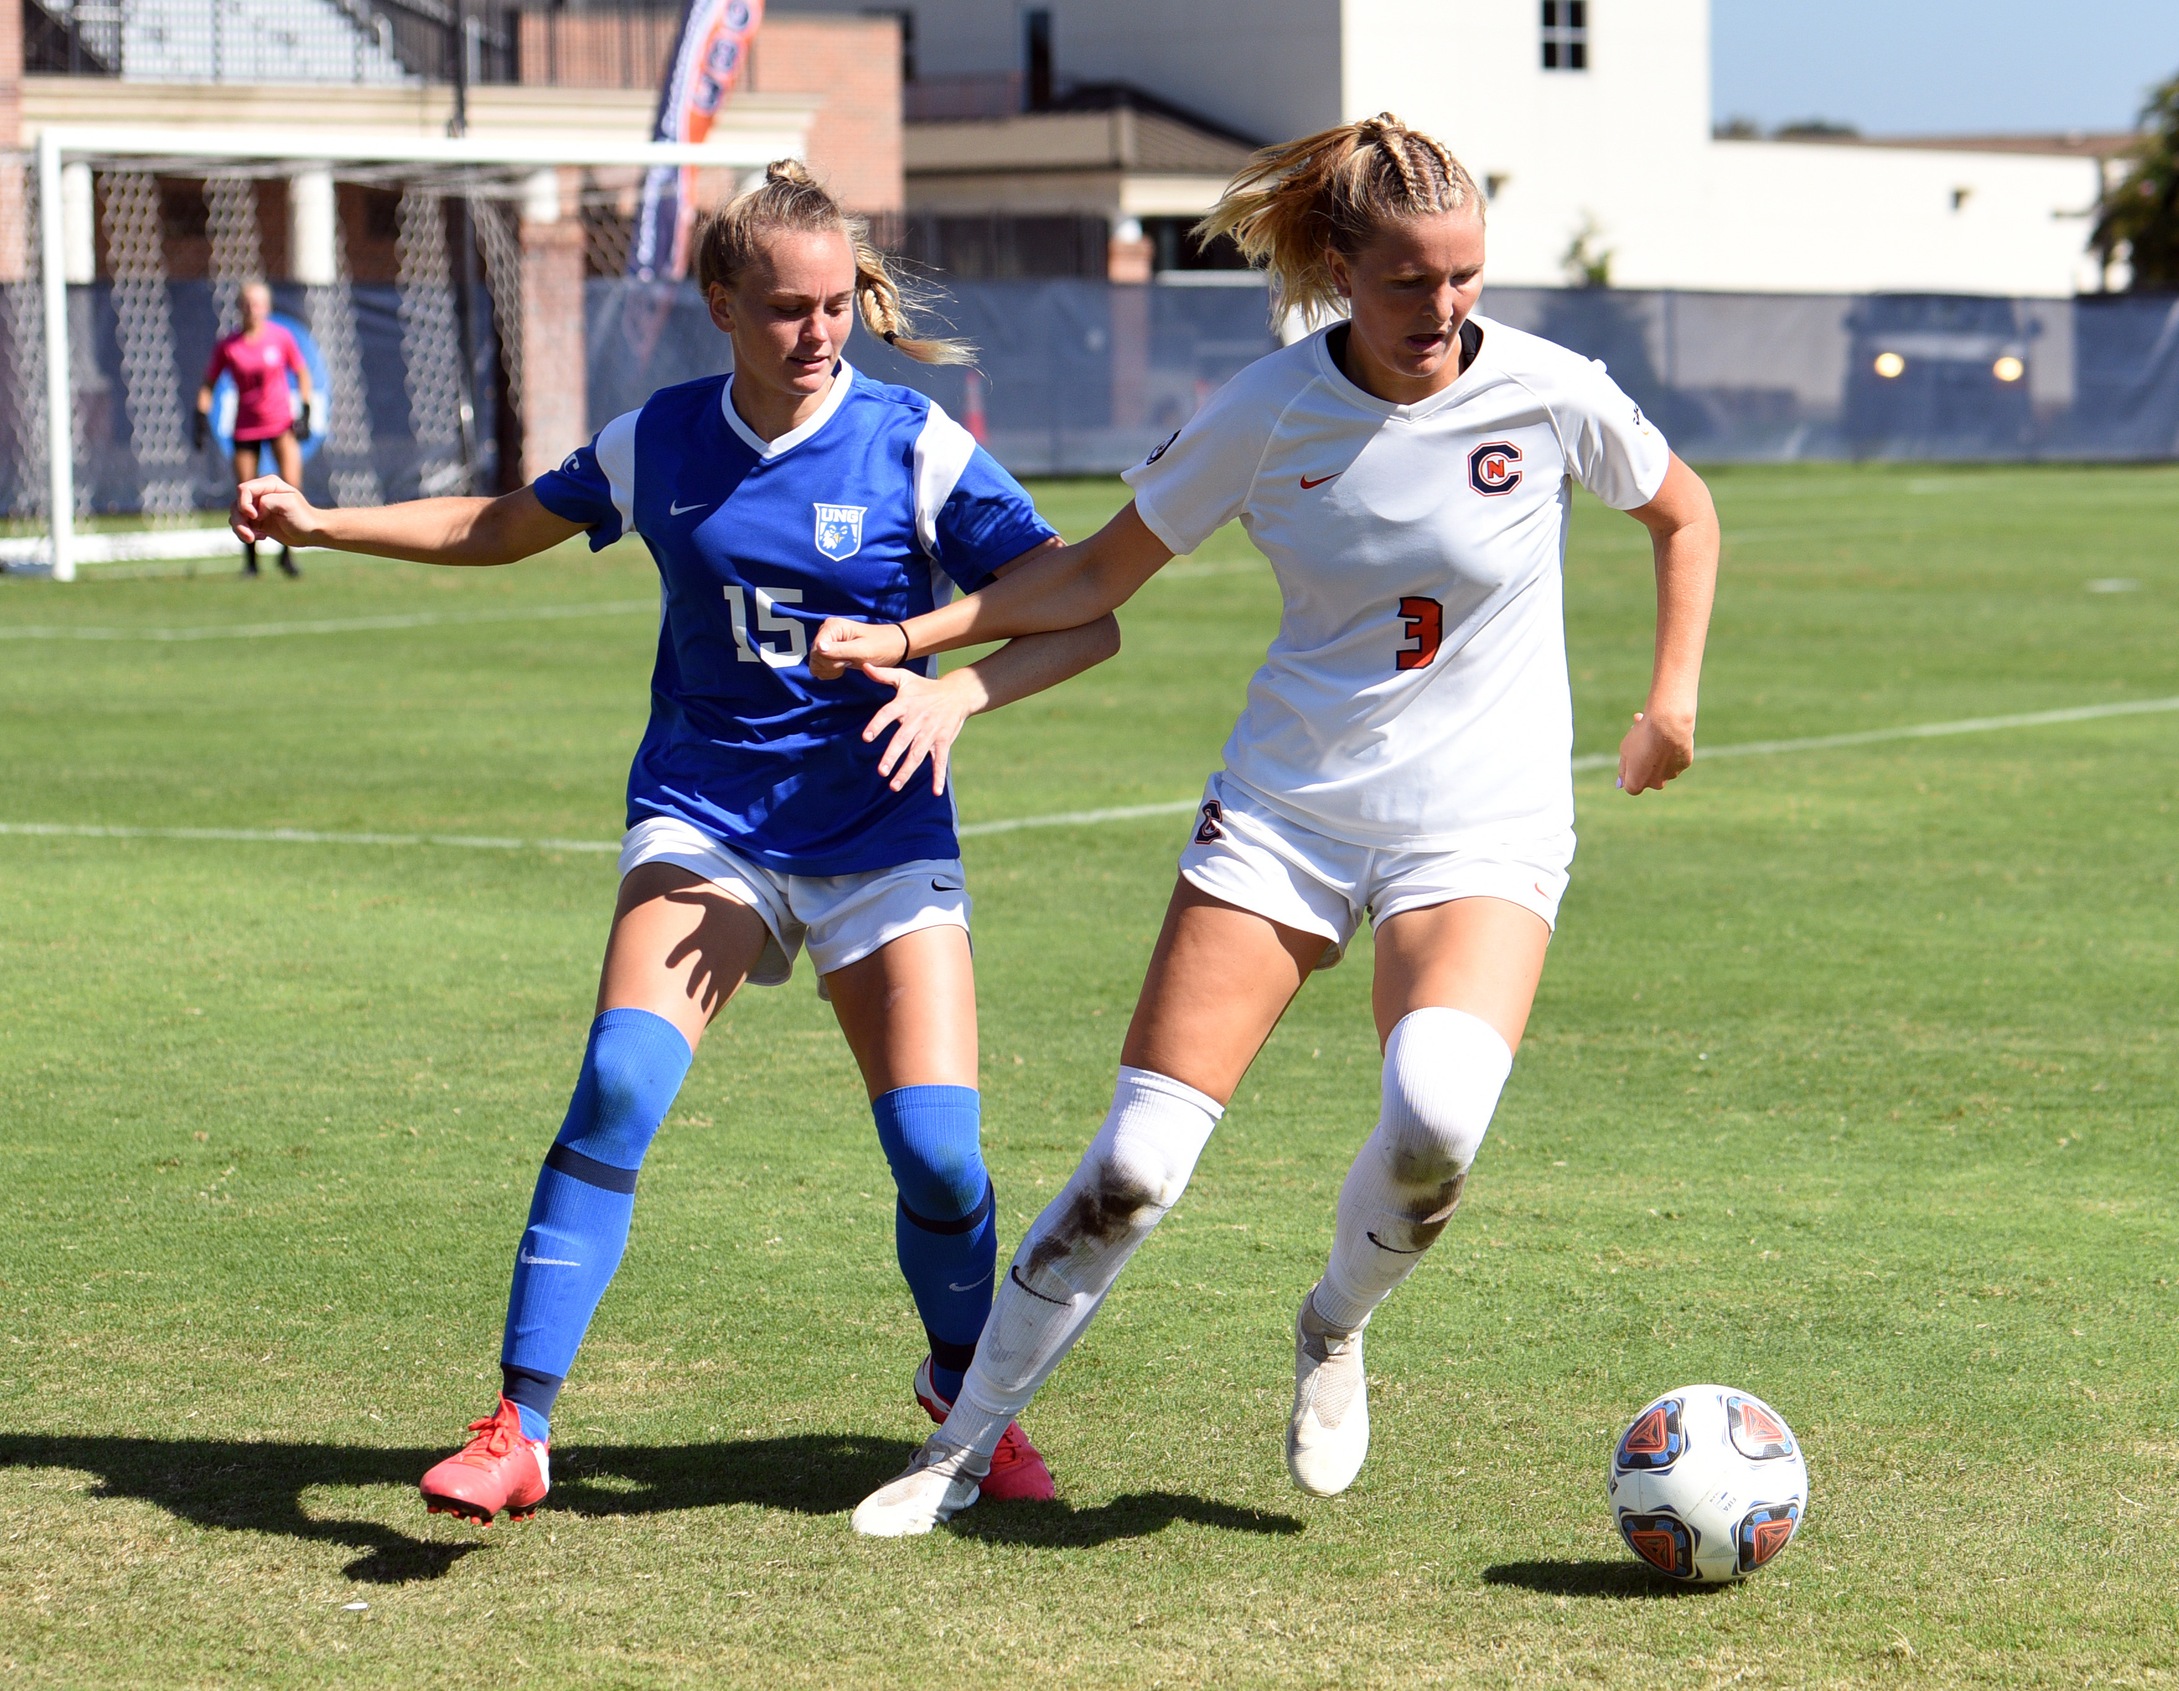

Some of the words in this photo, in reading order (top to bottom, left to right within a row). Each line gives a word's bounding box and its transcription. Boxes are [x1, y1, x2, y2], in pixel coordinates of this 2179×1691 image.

[821, 508, 860, 524] UNG
[723, 585, 808, 669] 15
[1395, 595, 1443, 671] 3
